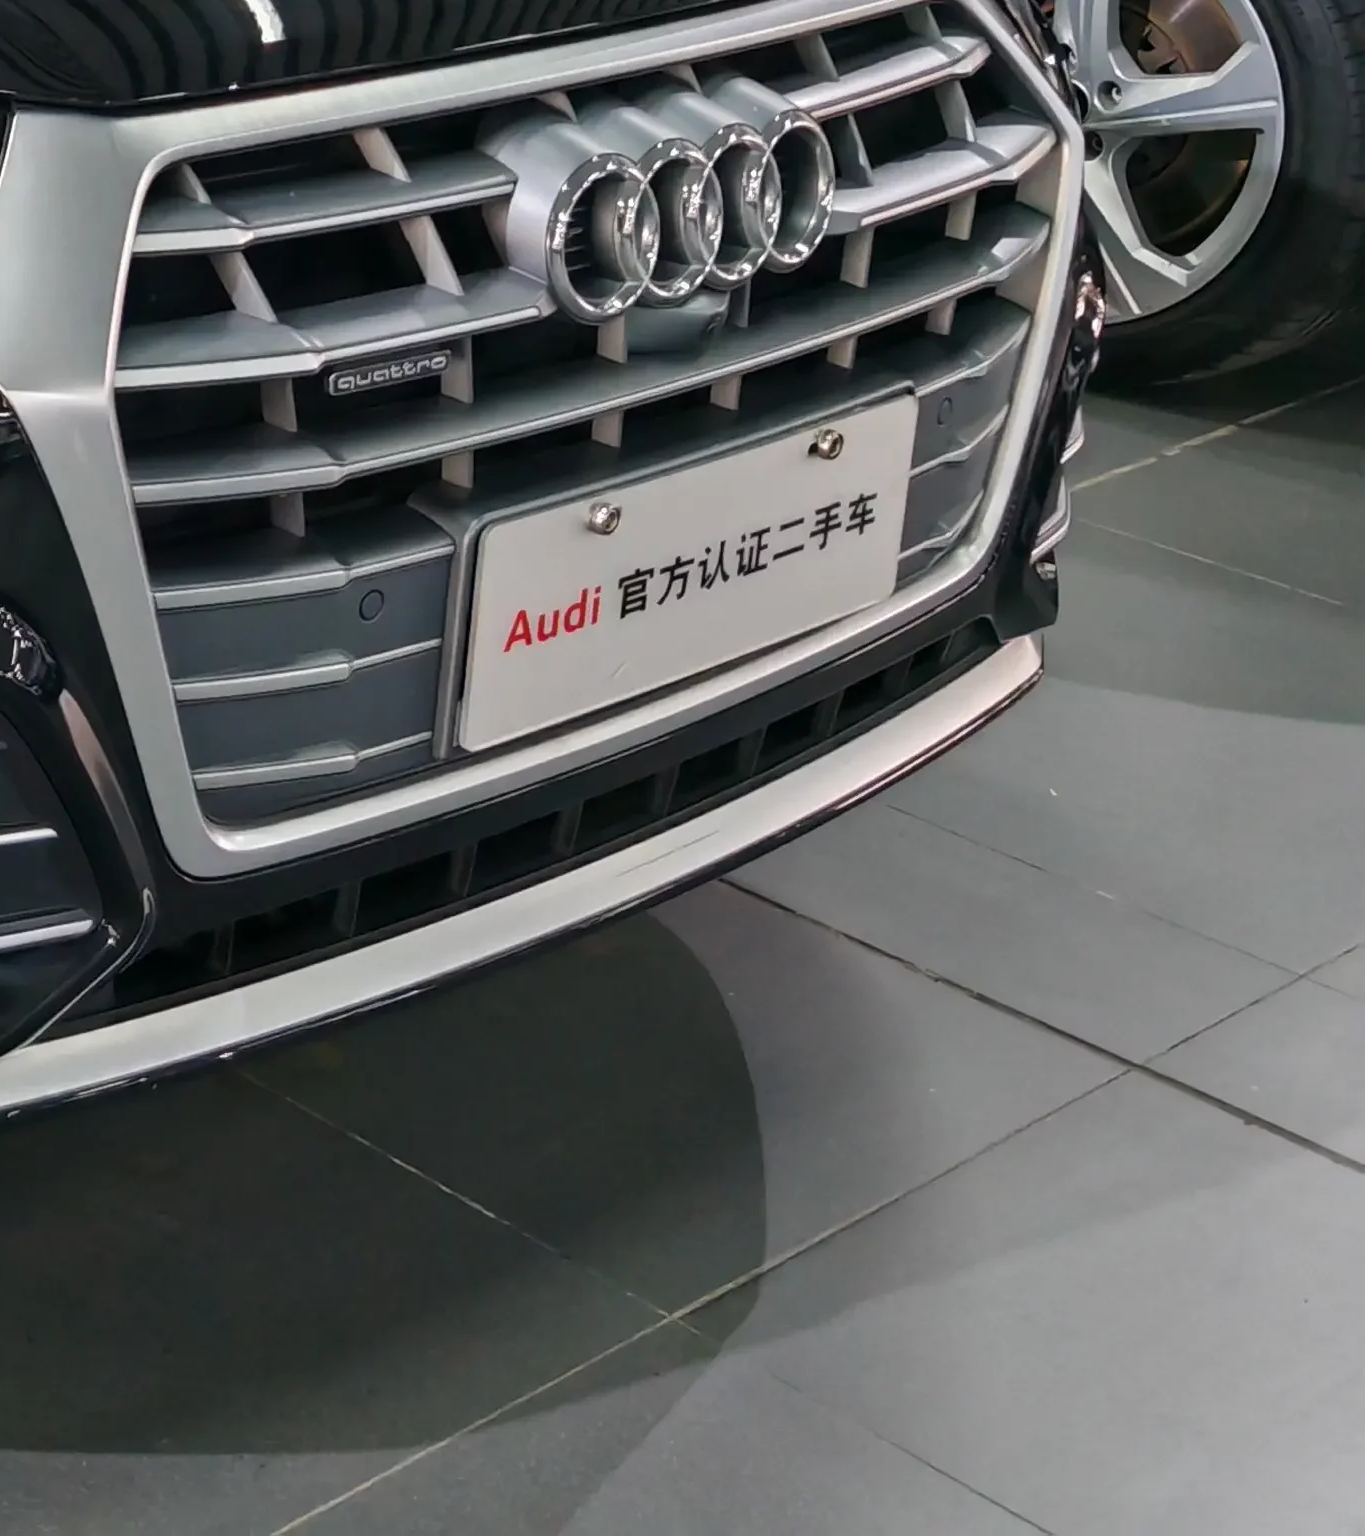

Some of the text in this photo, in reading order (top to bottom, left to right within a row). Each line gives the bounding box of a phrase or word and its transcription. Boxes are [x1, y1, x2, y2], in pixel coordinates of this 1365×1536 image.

[336, 352, 448, 393] quattro
[503, 491, 879, 653] Audi 官方认证二手车
